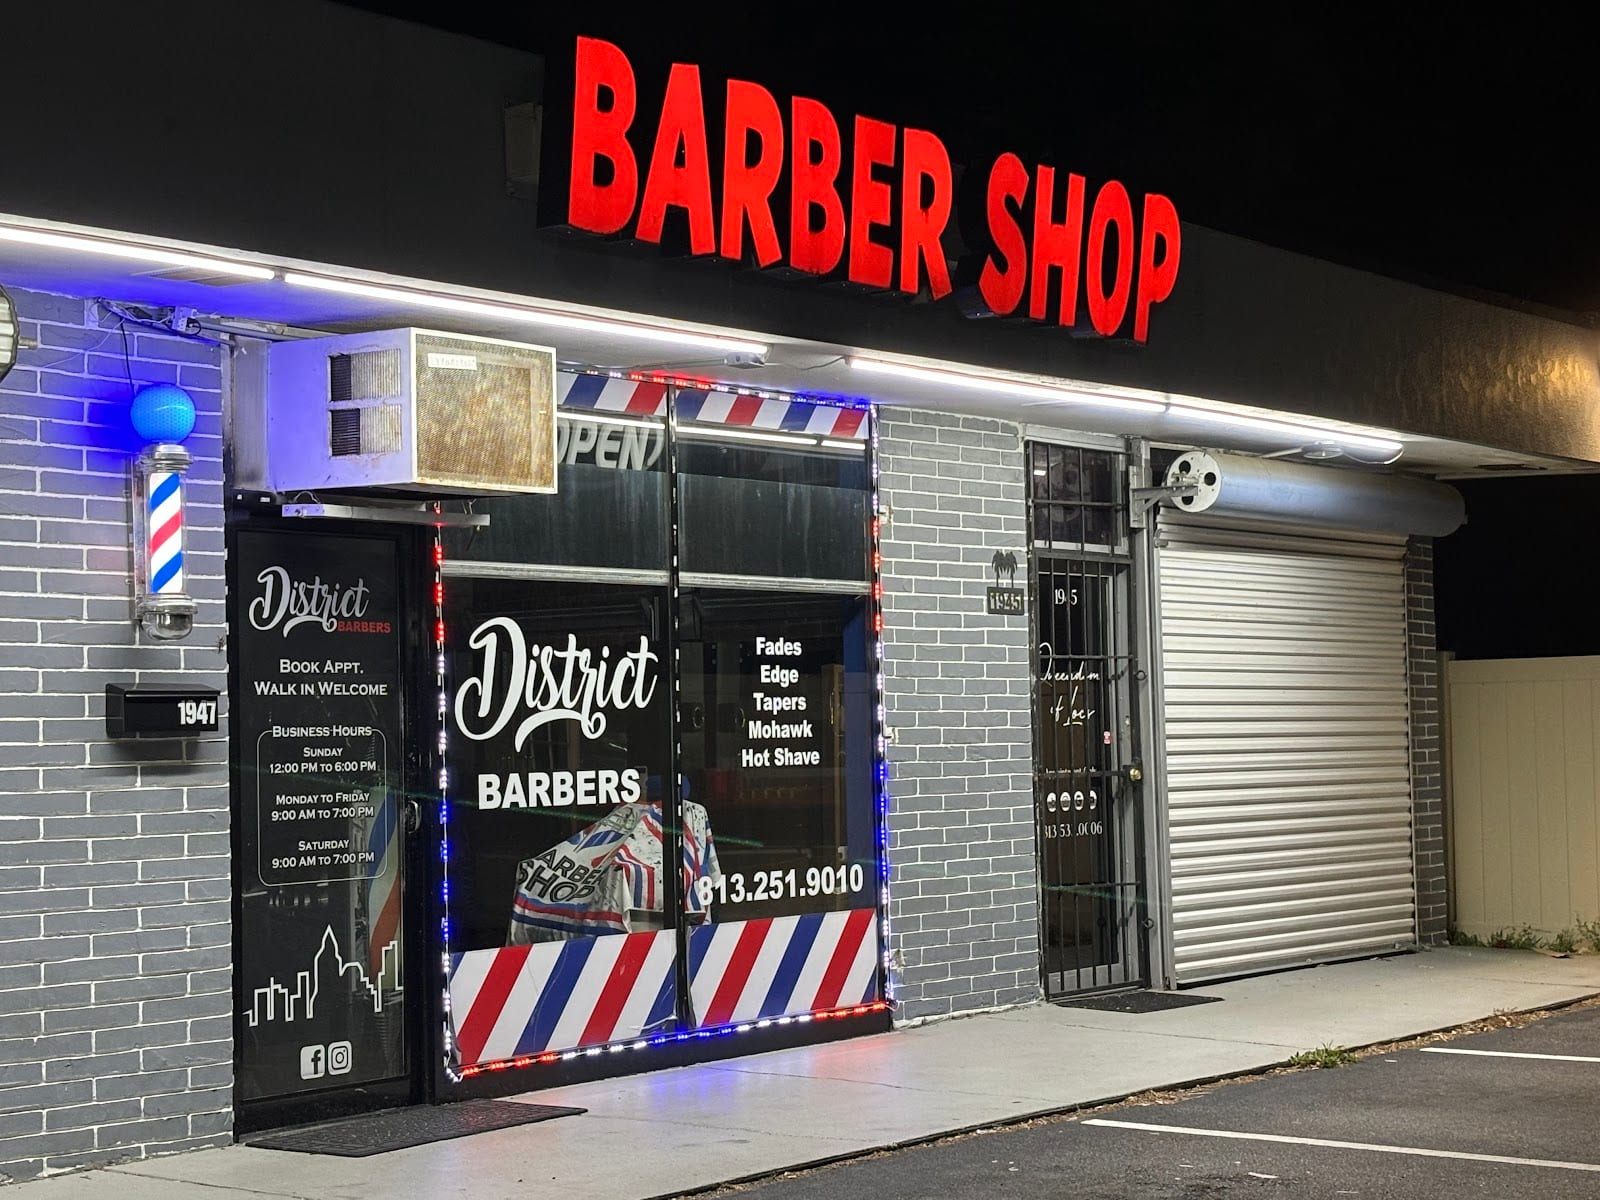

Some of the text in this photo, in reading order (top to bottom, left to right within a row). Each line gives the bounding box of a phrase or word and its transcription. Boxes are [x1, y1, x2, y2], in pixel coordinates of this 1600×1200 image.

[568, 35, 1181, 344] BARBER SHOP
[249, 565, 370, 638] District
[1054, 588, 1078, 606] 195
[337, 620, 391, 633] BARBERS
[755, 636, 802, 656] Fades
[279, 658, 364, 674] BOOK APPT.
[760, 664, 799, 687] Edge
[254, 681, 388, 696] WALK IN WELCOME
[454, 617, 659, 752] District
[177, 700, 217, 725] 1947
[752, 692, 807, 715] Tapers
[272, 724, 373, 738] BUSINESS HOURS
[748, 719, 813, 739] Mohawk
[303, 747, 343, 757] SUNDAY
[741, 747, 820, 767] Hot Shave
[269, 761, 377, 774] 12:00 PM TO 6:00 PM
[276, 792, 370, 805] MONDAY TO FRIDAY
[478, 768, 641, 810] BARBERS
[271, 806, 374, 821] 9:00 AM TO 7:00 PM
[298, 840, 350, 851] SATURDAY
[271, 852, 375, 869] 9:00 AM TO 7:00 PM
[698, 863, 864, 906] 813.251.9010
